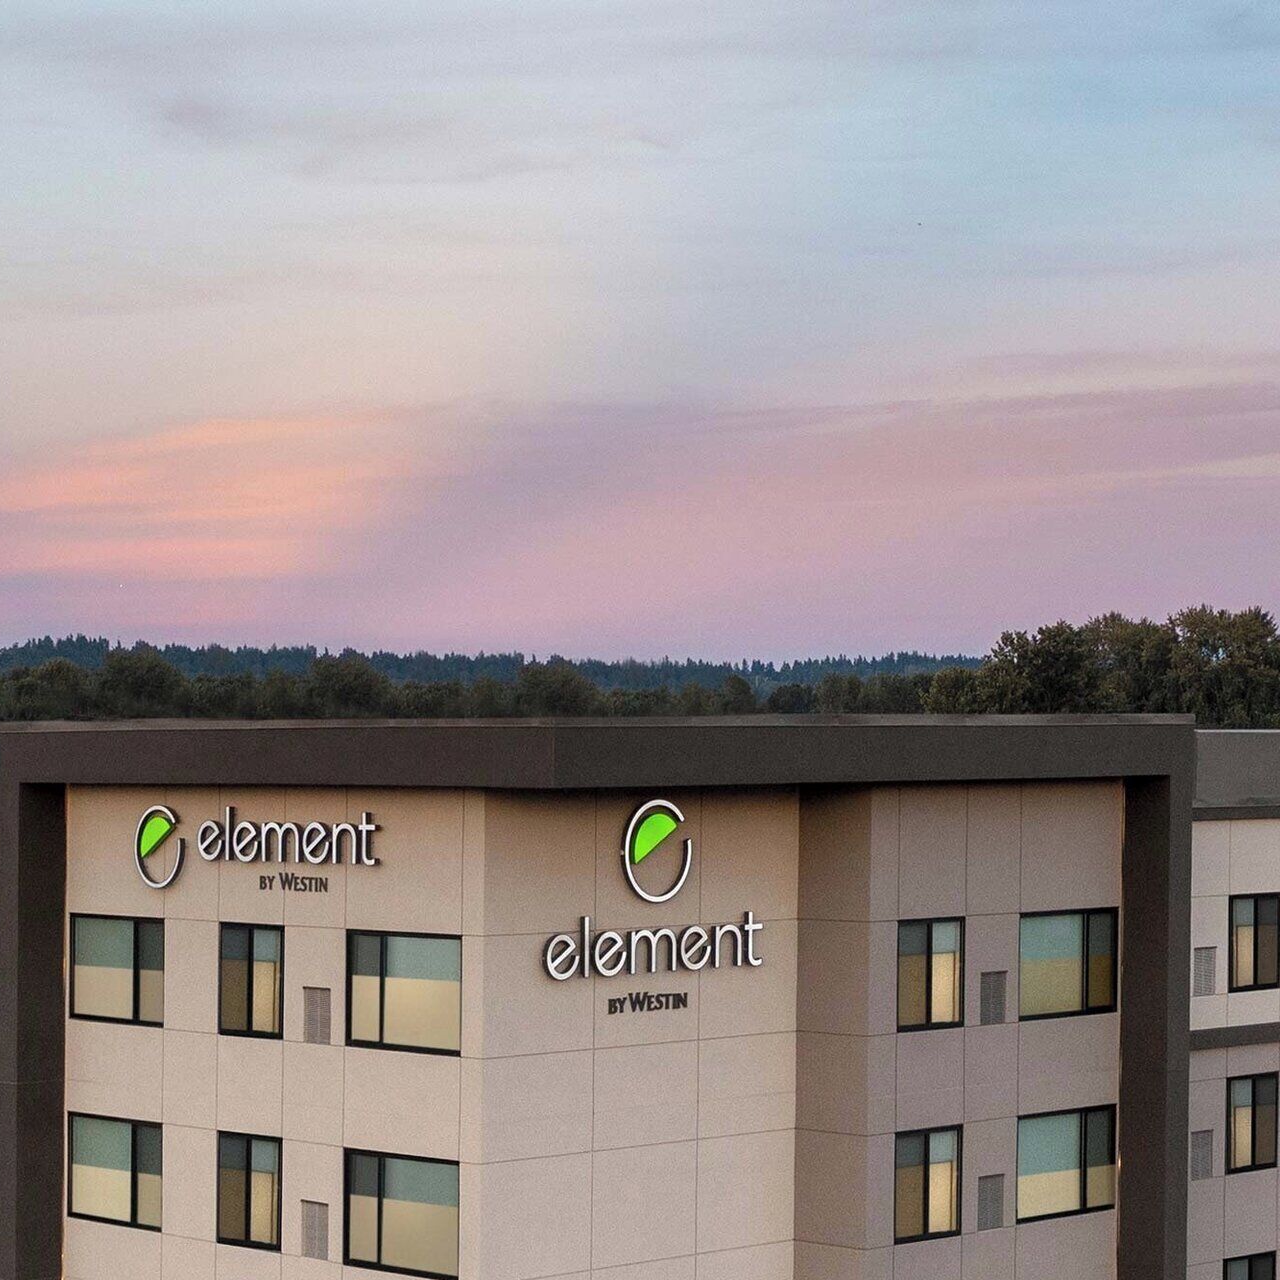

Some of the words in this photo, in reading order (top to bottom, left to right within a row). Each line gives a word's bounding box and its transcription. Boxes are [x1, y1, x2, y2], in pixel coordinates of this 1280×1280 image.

[197, 806, 378, 866] element
[259, 875, 275, 890] BY
[279, 871, 328, 892] WESTIN
[544, 911, 763, 981] element
[608, 997, 627, 1015] BY
[628, 992, 688, 1012] WESTIN
